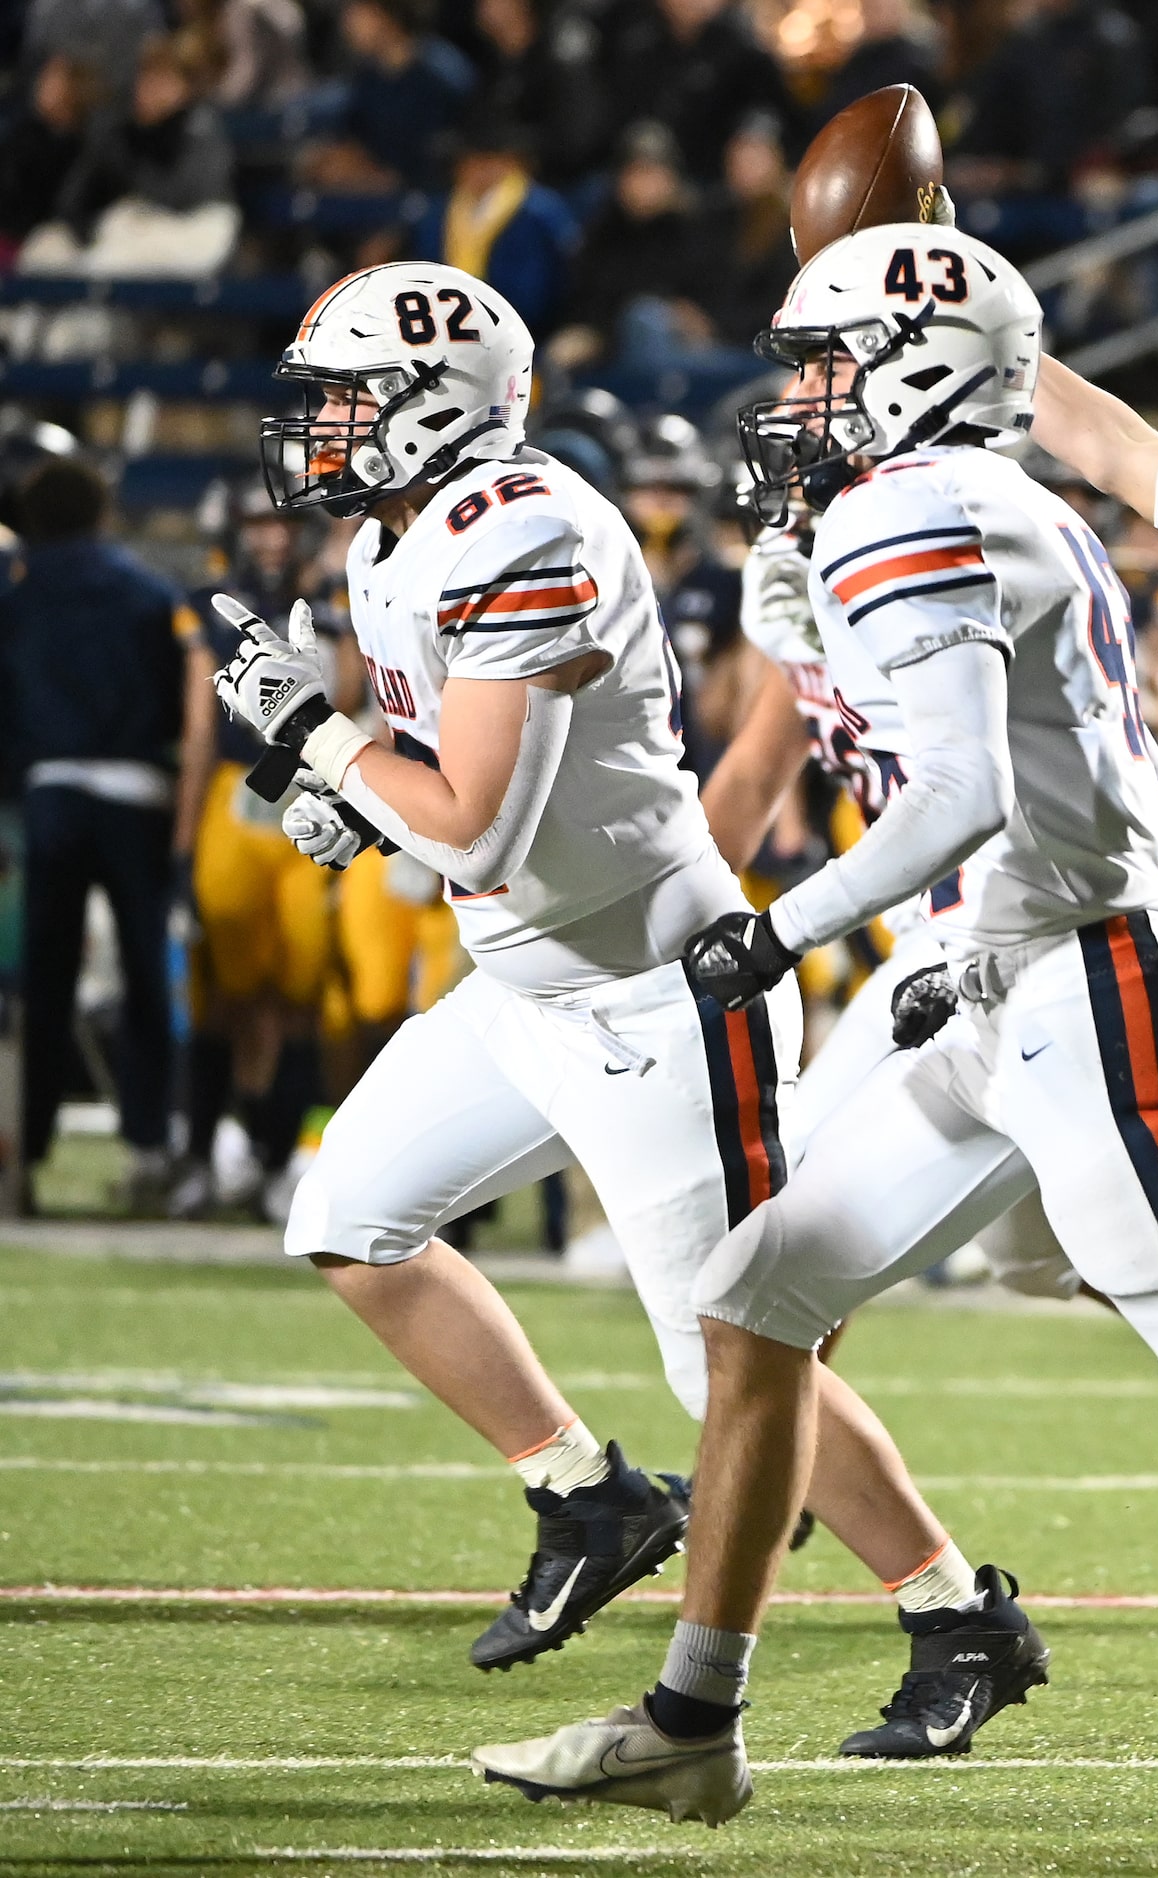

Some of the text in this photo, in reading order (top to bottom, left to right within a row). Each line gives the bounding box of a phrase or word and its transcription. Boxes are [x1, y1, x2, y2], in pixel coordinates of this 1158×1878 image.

[884, 248, 969, 304] 43
[394, 288, 481, 346] 82
[445, 472, 552, 536] 82
[261, 676, 297, 718] adidas
[952, 1652, 990, 1663] ALPHA
